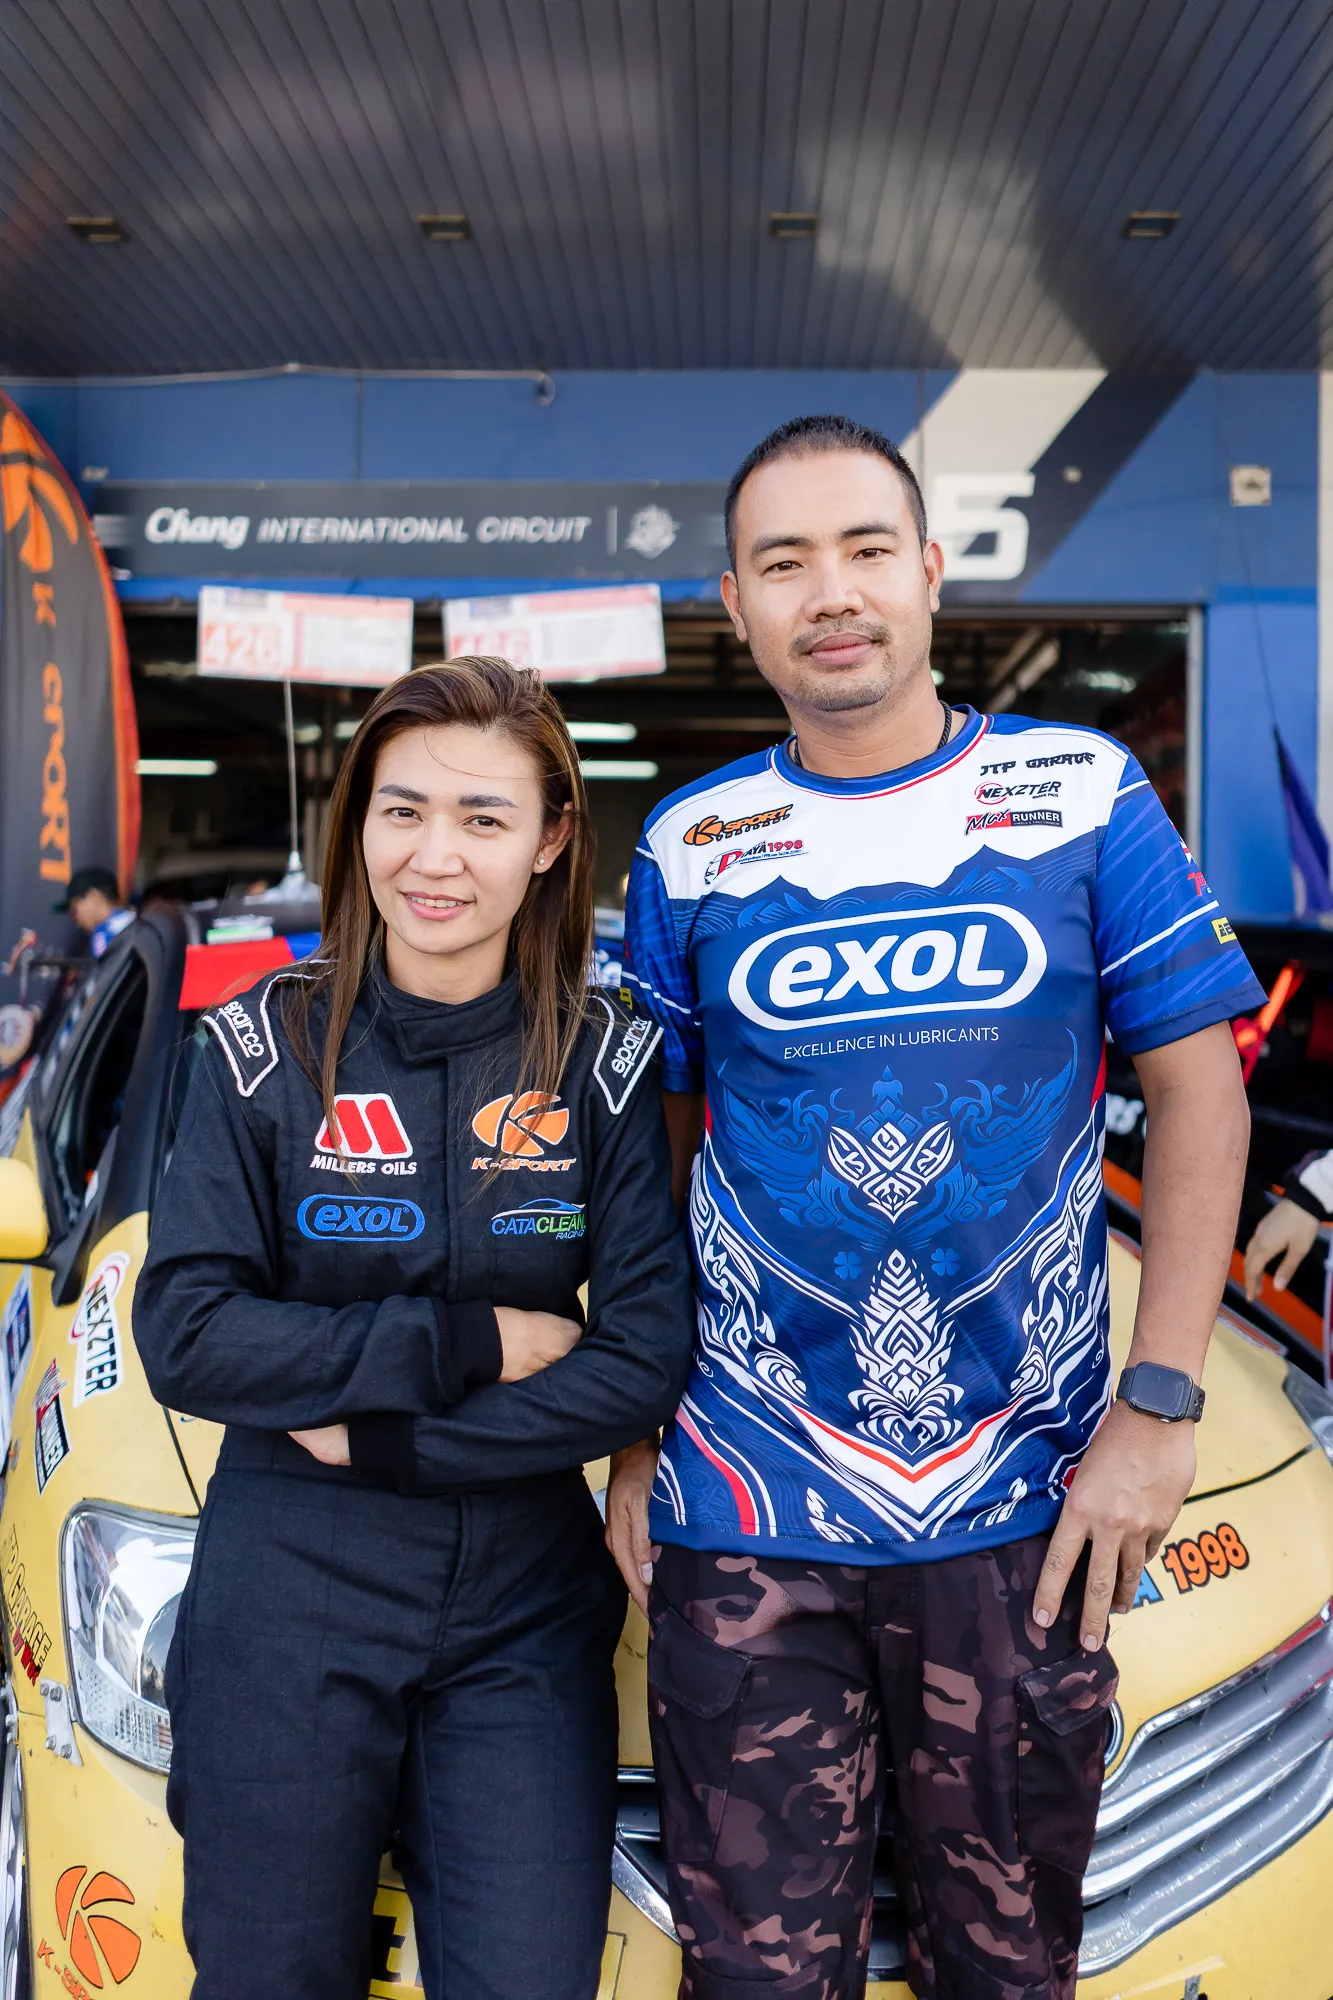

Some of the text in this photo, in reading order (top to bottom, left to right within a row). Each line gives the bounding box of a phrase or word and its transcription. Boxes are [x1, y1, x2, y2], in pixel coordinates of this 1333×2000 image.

[144, 506, 592, 550] Chang INTERNATIONAL CIRCUIT
[980, 752, 1096, 776] JTP GARAGE
[976, 781, 1062, 800] NEXZTER
[1012, 813, 1060, 824] RUNNER
[214, 1001, 265, 1057] sparco
[783, 1026, 999, 1060] EXCELLENCE IN LUBRICANTS
[310, 1154, 418, 1176] MILLERS OILS
[555, 1228, 585, 1240] RACING
[85, 1274, 118, 1397] NEXZTER
[1160, 1522, 1250, 1595] 1998
